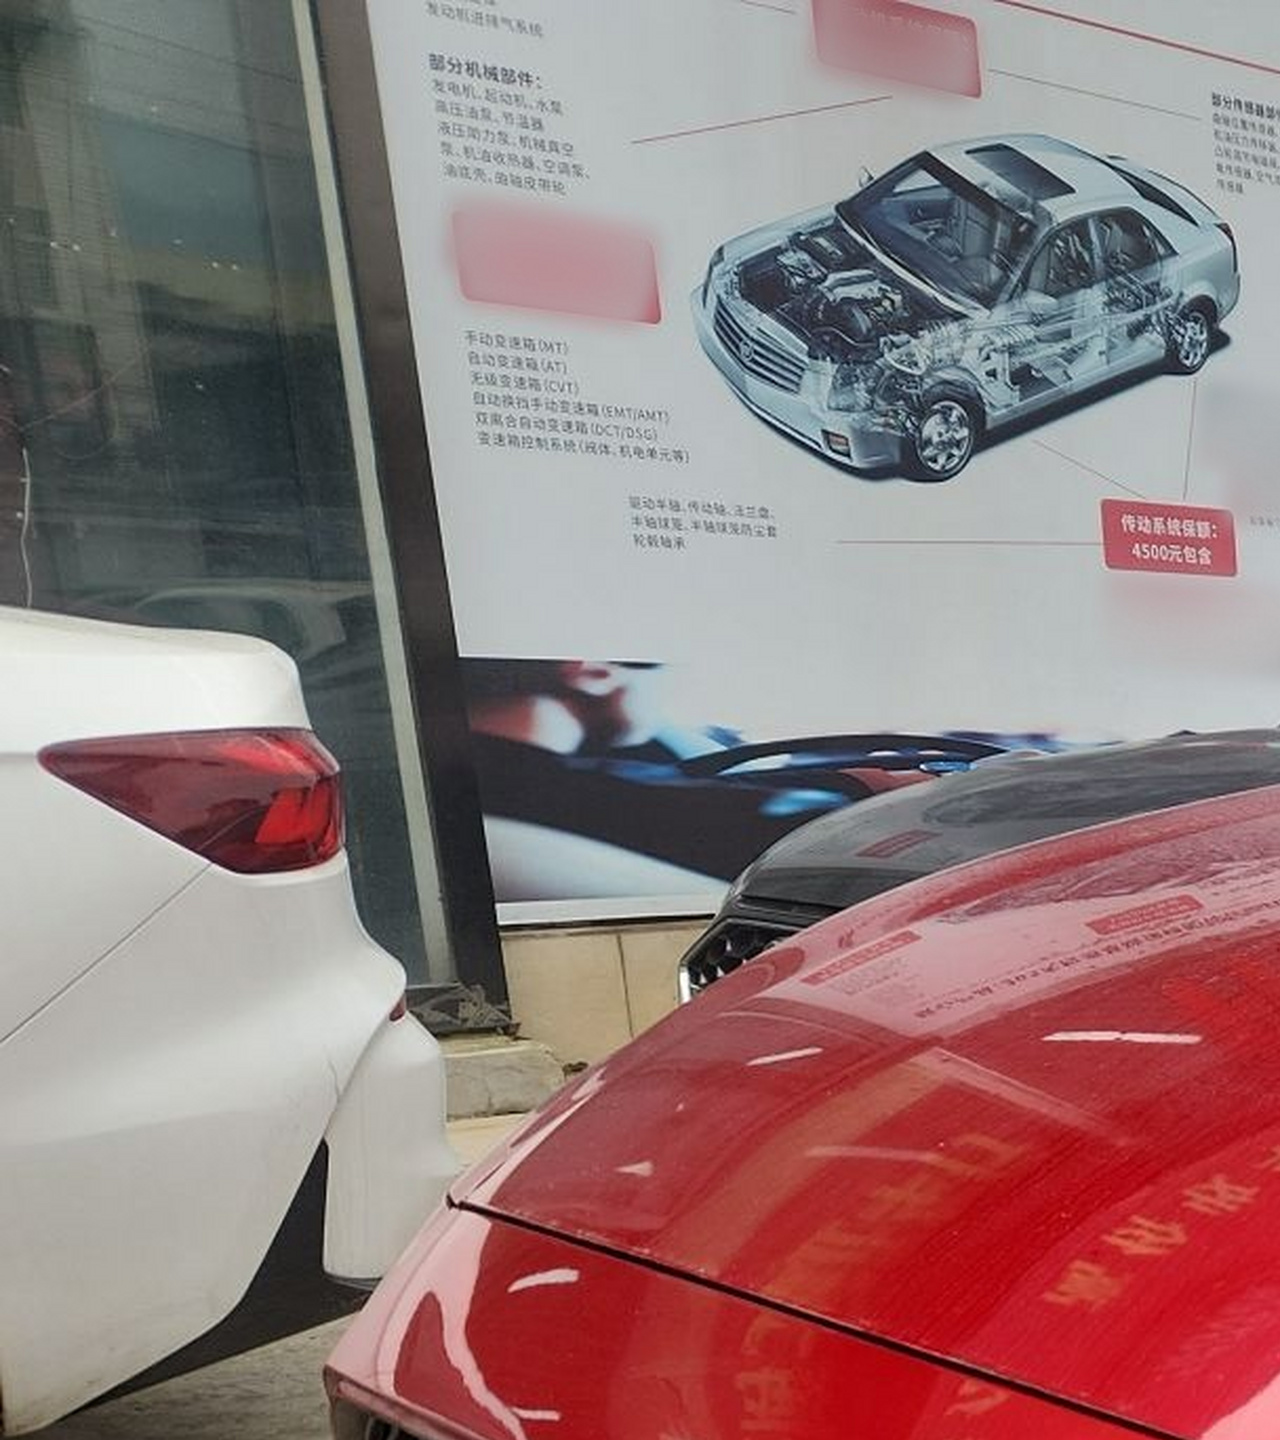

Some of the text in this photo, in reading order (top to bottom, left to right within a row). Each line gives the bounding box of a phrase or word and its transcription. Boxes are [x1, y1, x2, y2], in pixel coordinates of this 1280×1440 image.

[428, 53, 543, 89] 部分机械部件：
[1121, 513, 1217, 539] 传动系统保额：
[1132, 542, 1212, 566] 4500元包含
